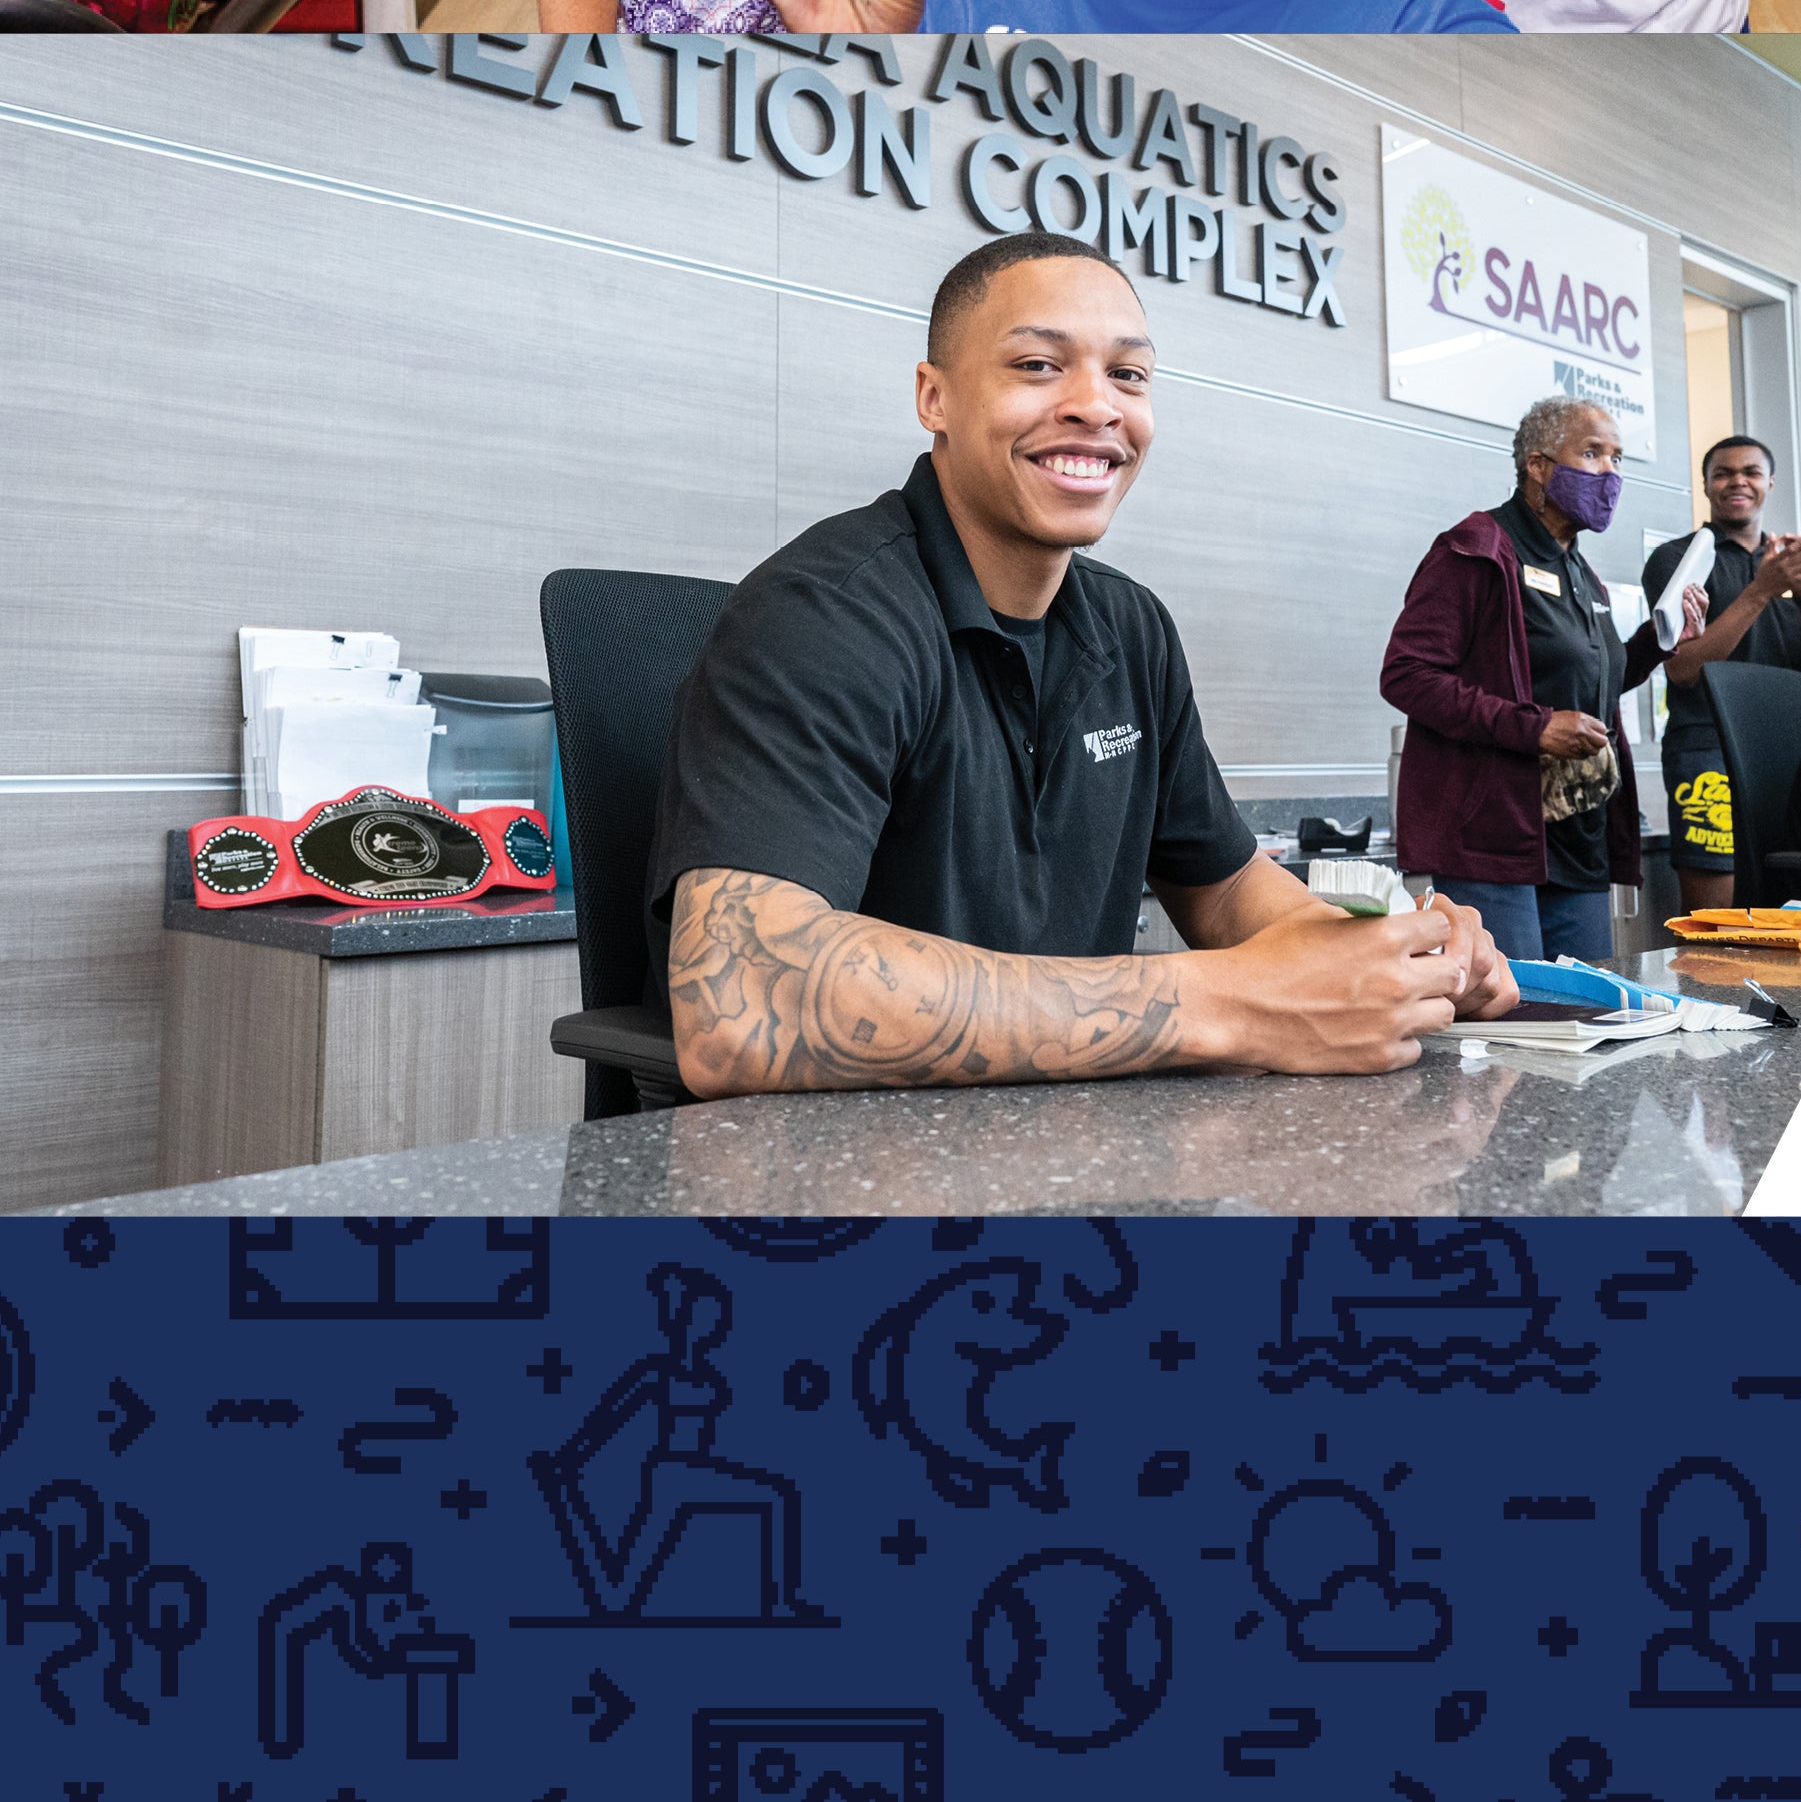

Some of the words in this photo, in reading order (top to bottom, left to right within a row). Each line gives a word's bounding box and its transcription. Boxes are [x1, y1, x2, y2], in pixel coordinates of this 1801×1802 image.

[926, 34, 1348, 235] AQUATICS
[960, 132, 1348, 328] COMPLEX
[1484, 246, 1641, 360] SAARC
[1577, 367, 1611, 391] Parks
[1098, 725, 1127, 741] Parks
